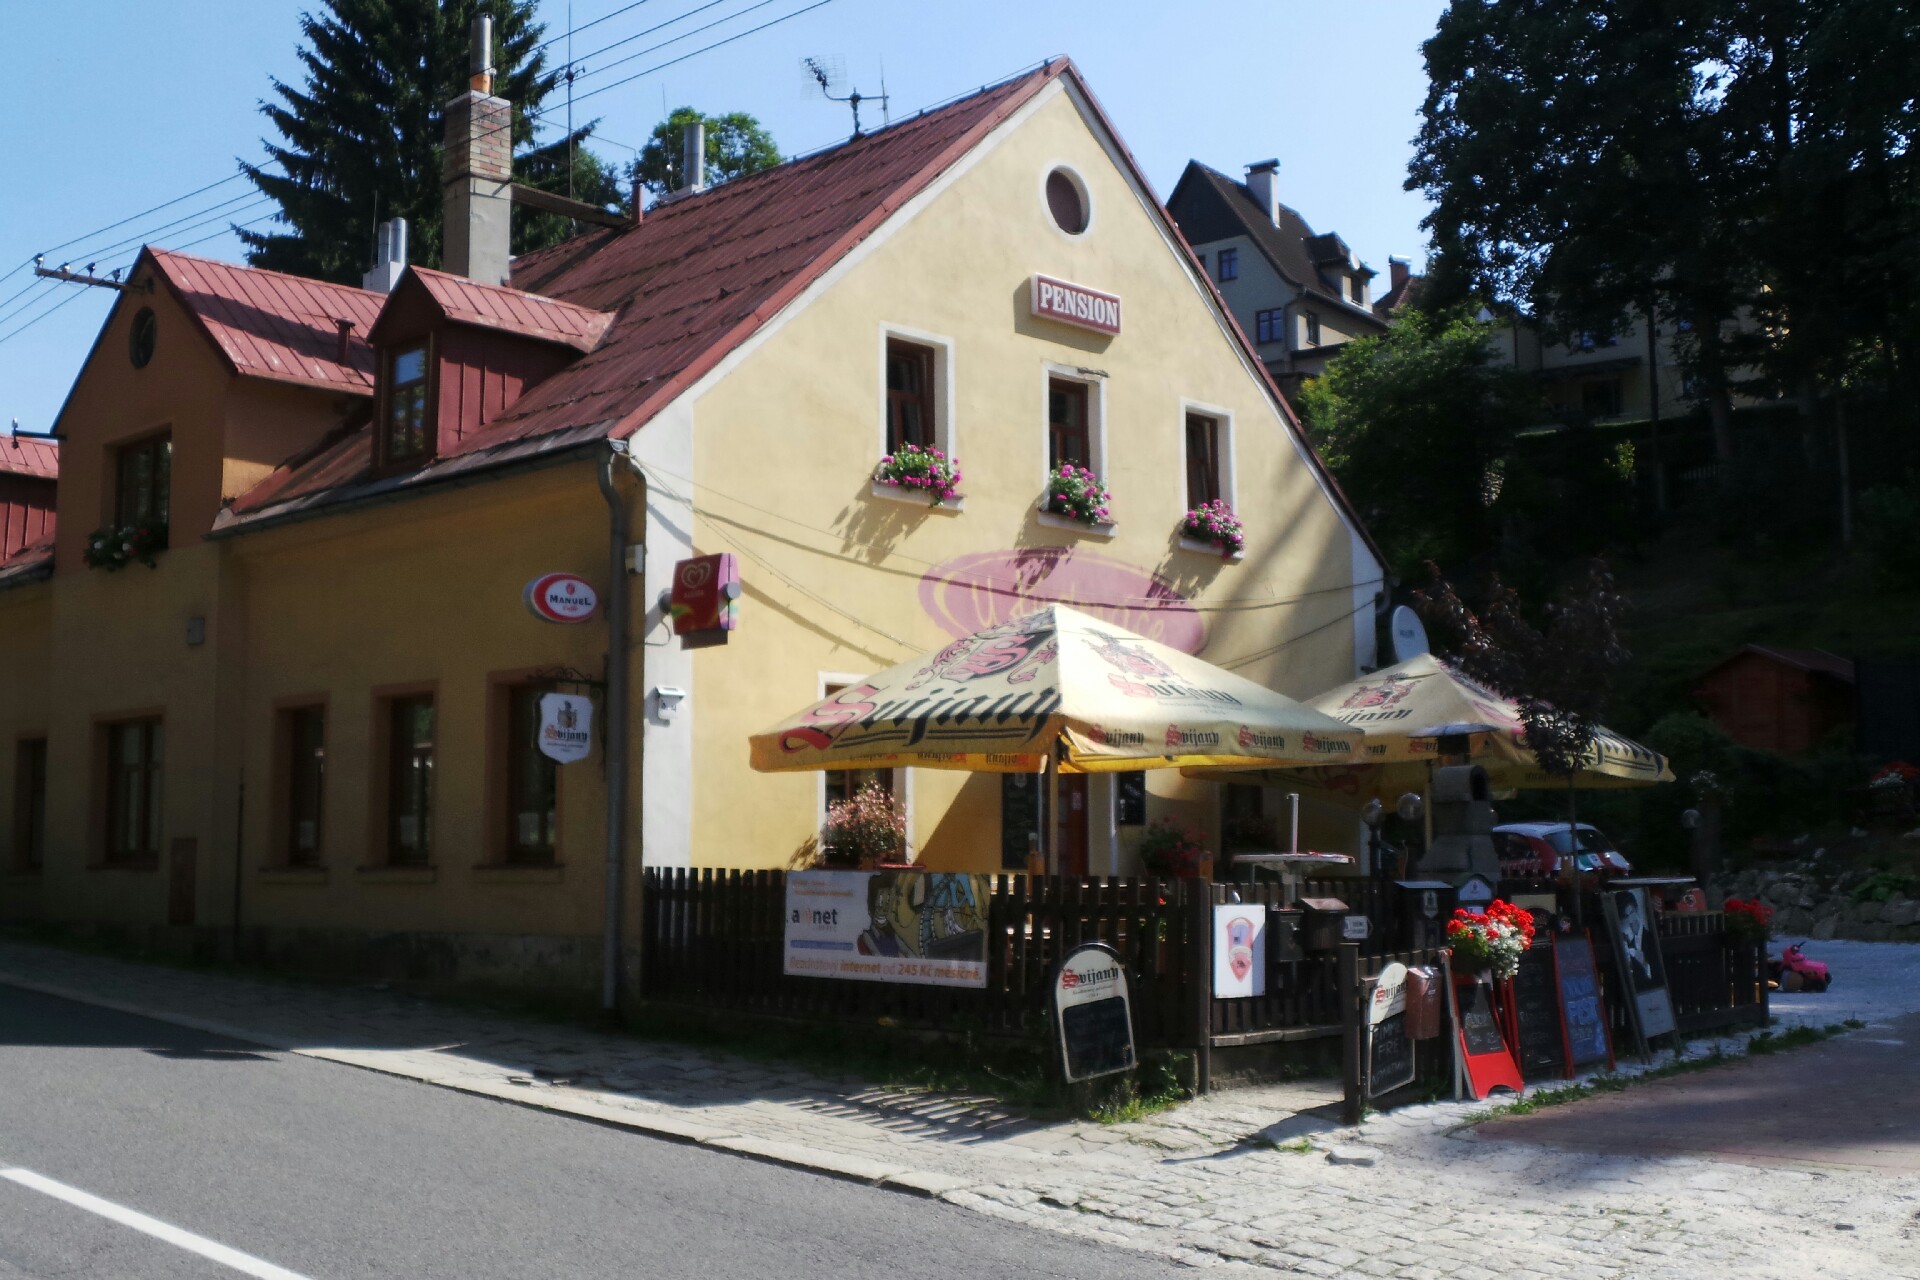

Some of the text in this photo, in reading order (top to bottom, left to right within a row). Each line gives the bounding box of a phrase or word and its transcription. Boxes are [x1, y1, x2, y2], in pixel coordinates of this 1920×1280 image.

[1040, 281, 1118, 327] PENSION
[779, 683, 1061, 753] Svijany
[545, 724, 588, 743] Svijany
[1088, 724, 1144, 748] Svijany
[1166, 723, 1219, 747] Svijany
[1239, 725, 1285, 751] Svijany
[1302, 731, 1351, 753] Svijany
[840, 959, 880, 974] internet
[898, 963, 918, 976] 245
[1062, 967, 1119, 989] Svijany
[1375, 982, 1407, 1005] Svijan
